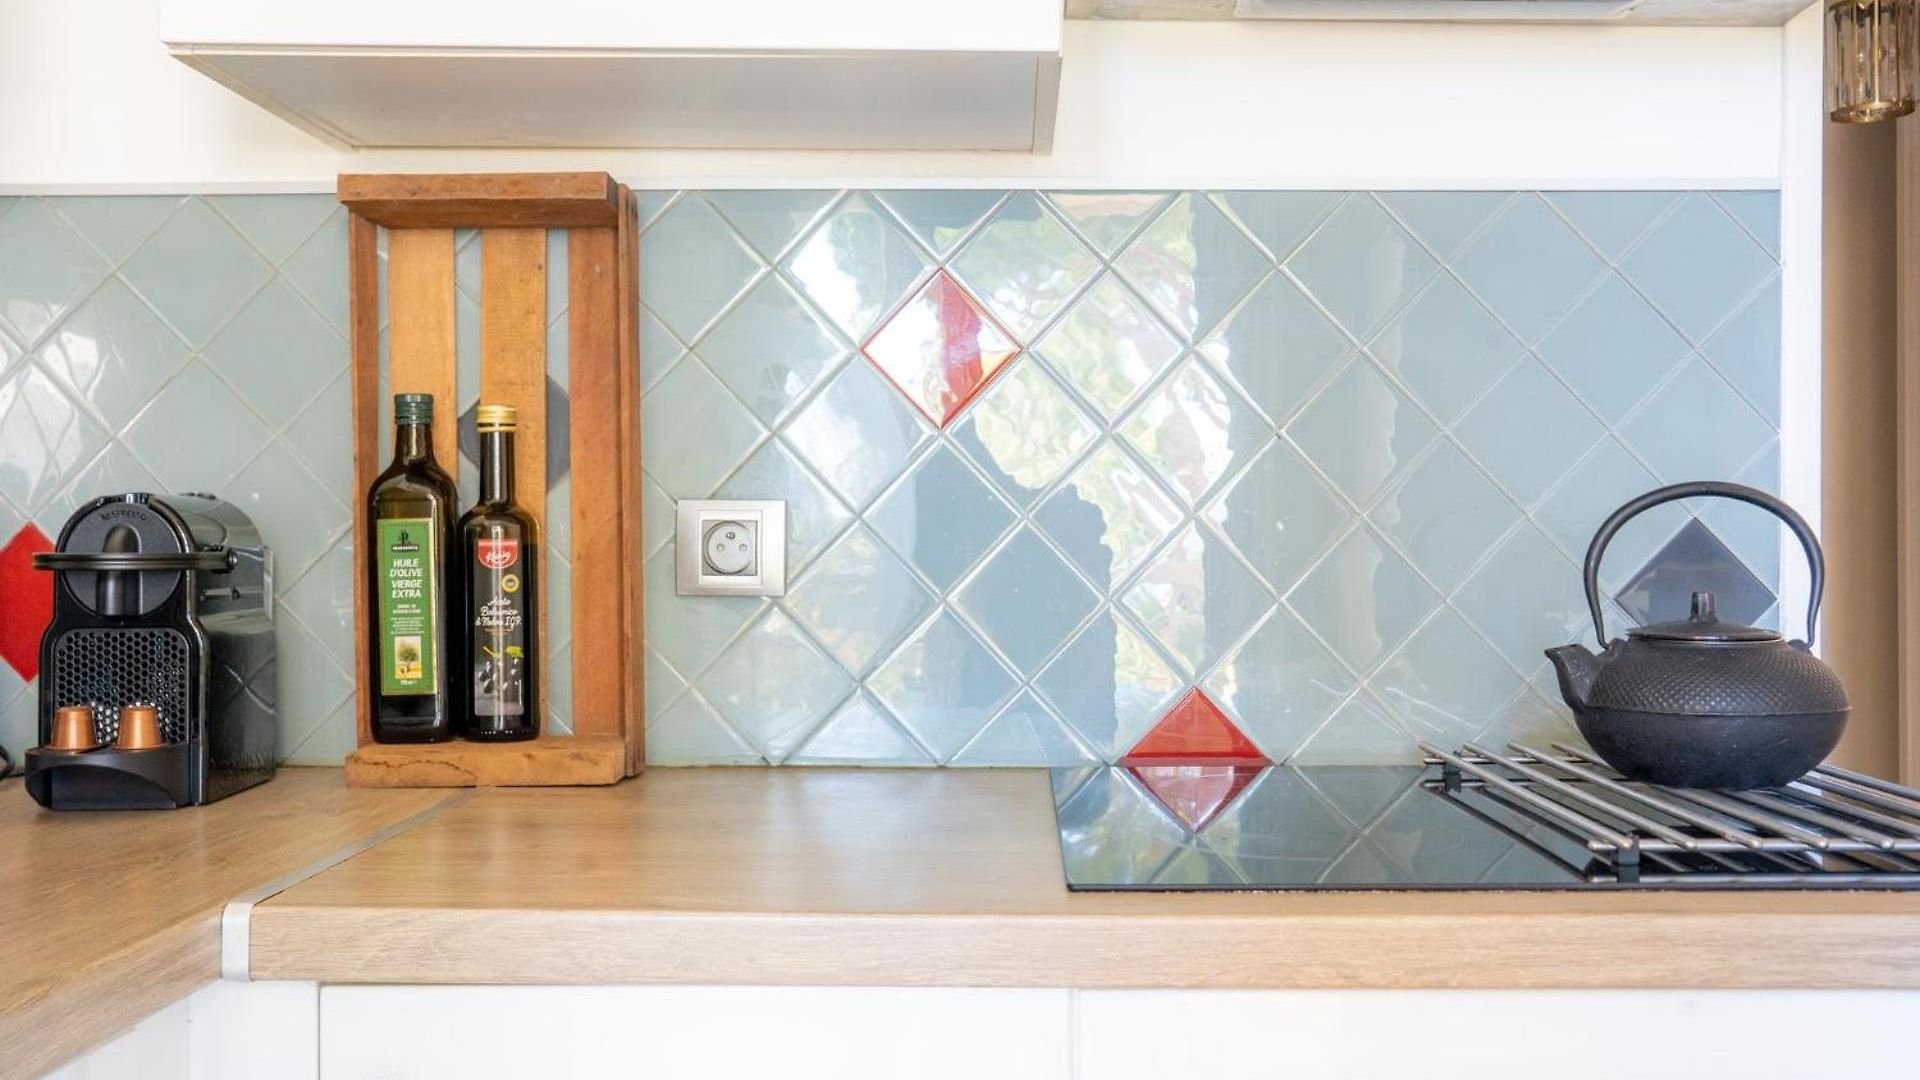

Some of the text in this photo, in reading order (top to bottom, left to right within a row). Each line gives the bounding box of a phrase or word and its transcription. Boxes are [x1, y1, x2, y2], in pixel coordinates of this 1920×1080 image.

[393, 558, 420, 568] HUILE
[389, 568, 424, 578] D'OLIVE
[391, 579, 423, 589] VIERGE
[391, 589, 422, 599] EXTRA
